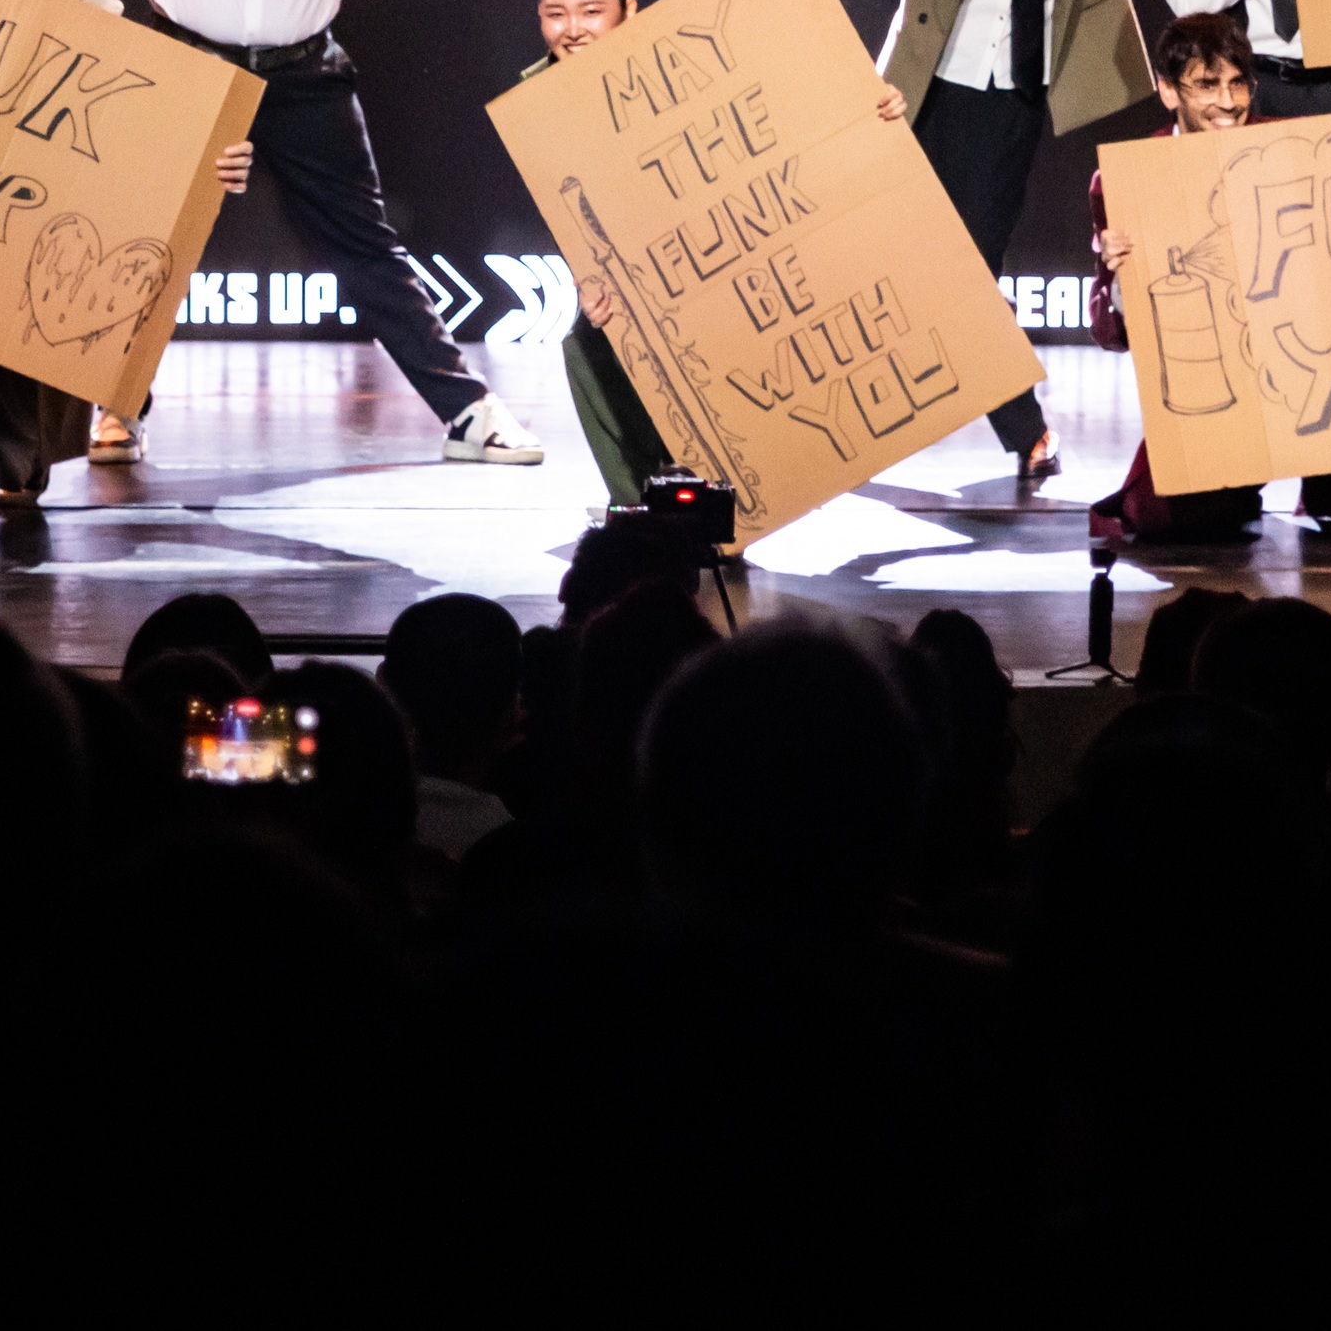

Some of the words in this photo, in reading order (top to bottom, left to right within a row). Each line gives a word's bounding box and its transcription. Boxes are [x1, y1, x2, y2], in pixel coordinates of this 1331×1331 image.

[637, 82, 777, 200] THE
[646, 154, 819, 299] FUNK
[732, 244, 815, 333] BE
[269, 272, 358, 325] UP.
[726, 276, 910, 412] WITH
[789, 327, 959, 462] YOU
